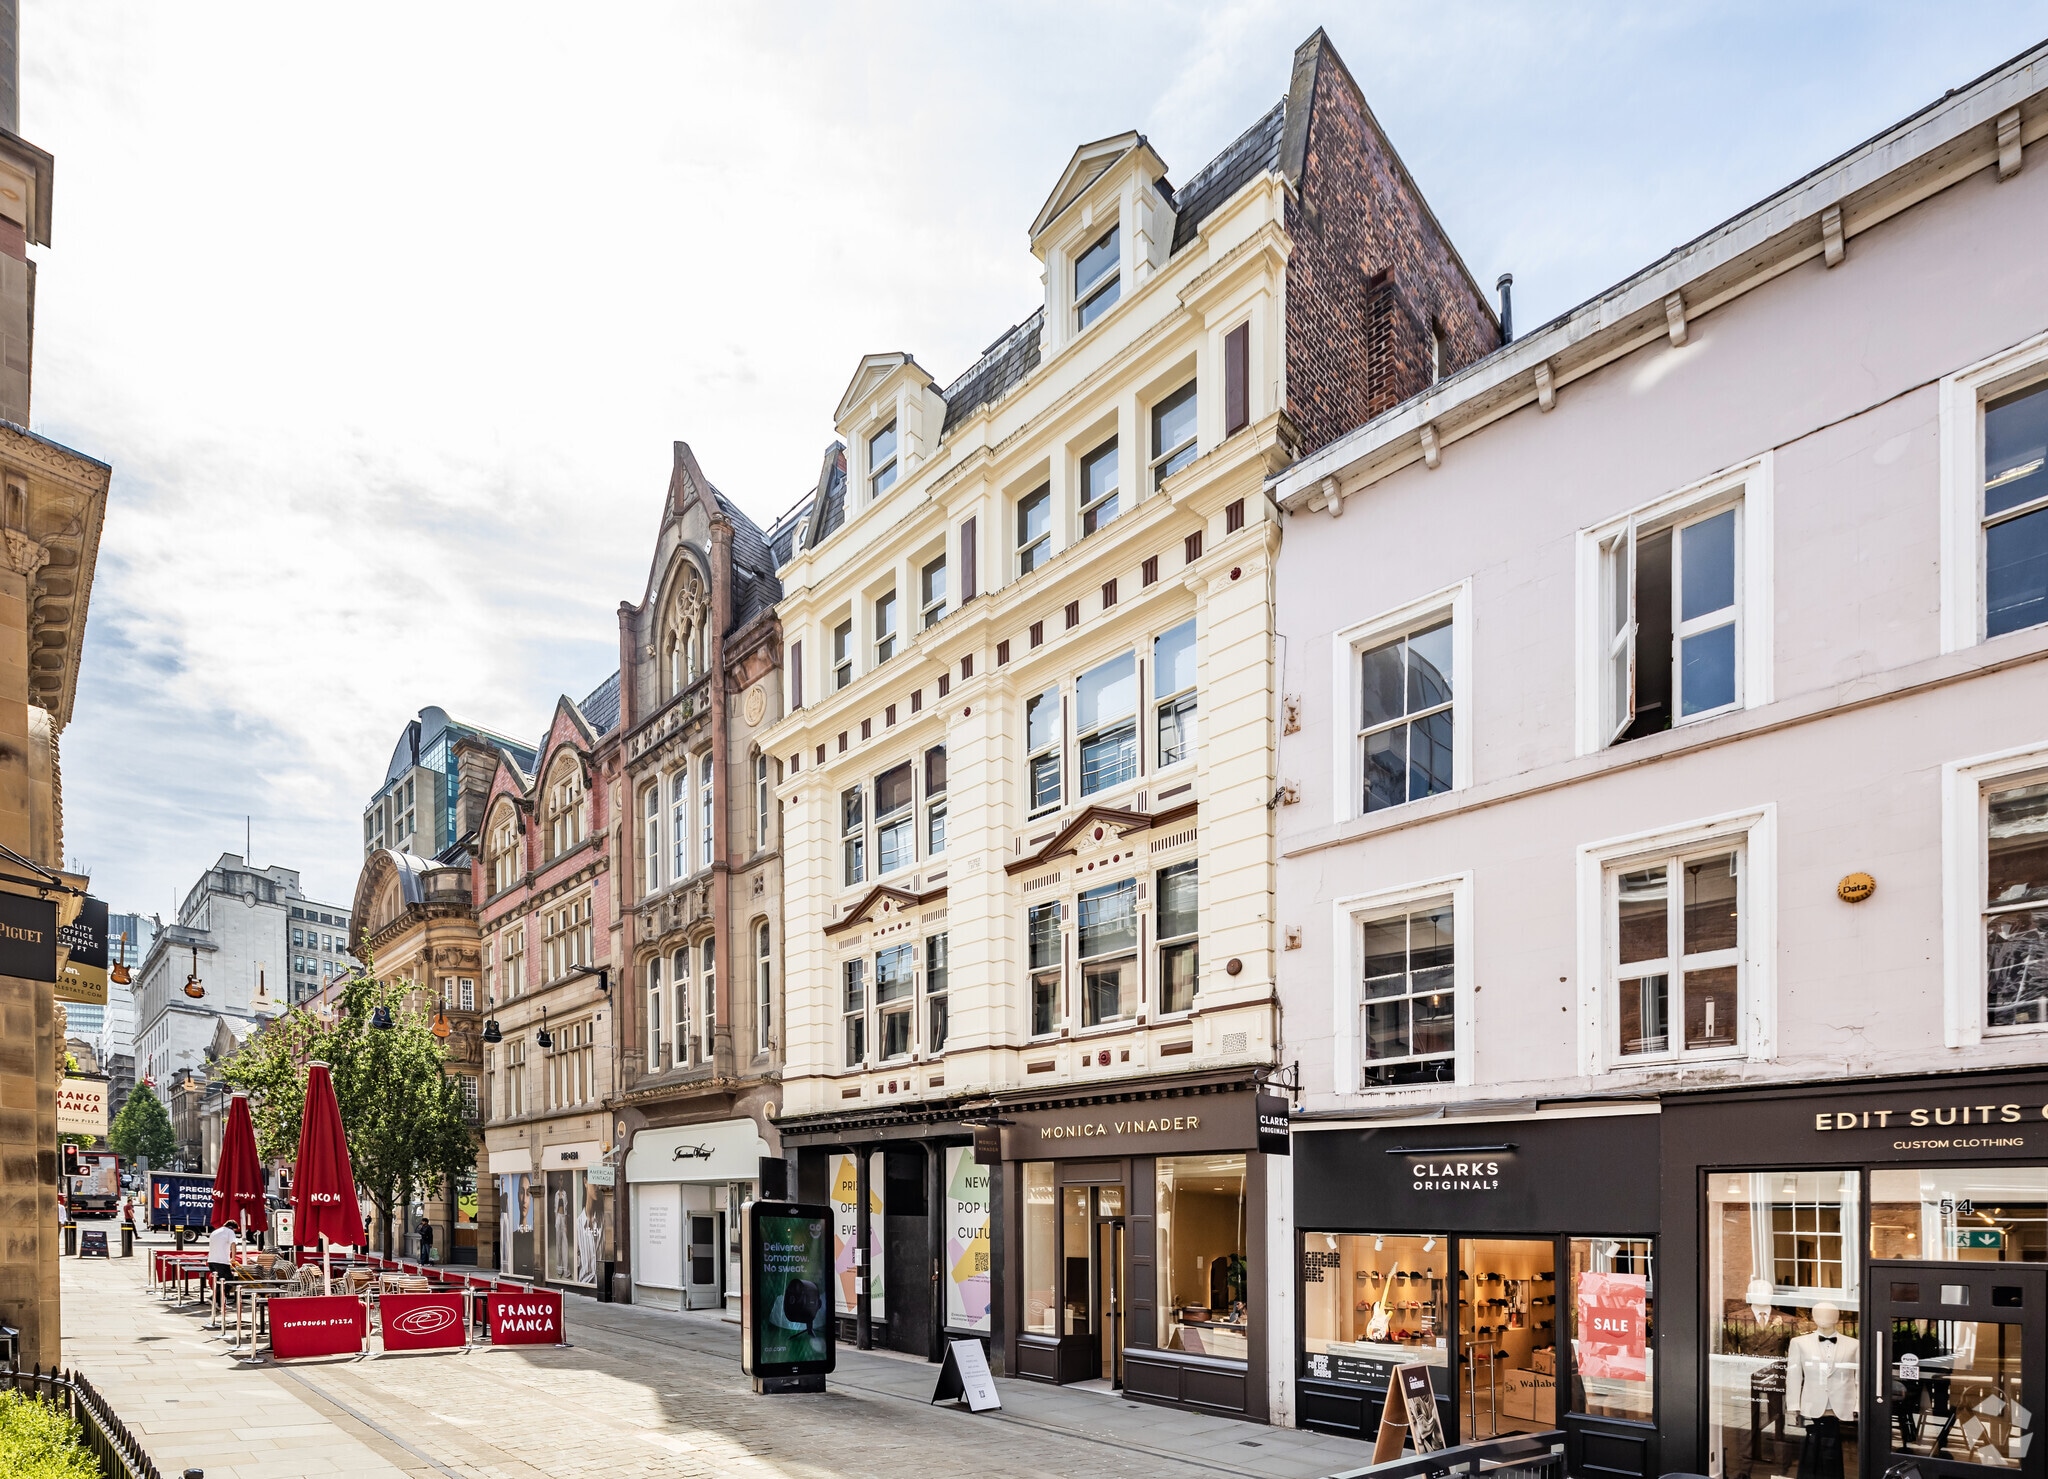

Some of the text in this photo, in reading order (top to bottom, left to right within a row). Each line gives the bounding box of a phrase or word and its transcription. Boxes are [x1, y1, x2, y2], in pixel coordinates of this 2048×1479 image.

[1843, 884, 1868, 894] Data
[62, 927, 93, 941] OFFICE
[71, 923, 93, 933] ALITY
[61, 933, 99, 949] TERRACE
[77, 945, 87, 953] FT
[82, 981, 102, 991] 920
[57, 1090, 101, 1102] RANCO
[1260, 1114, 1289, 1127] CLARKS
[1815, 1110, 1893, 1131] EDIT
[1910, 1103, 2021, 1127] SUITS
[1041, 1116, 1200, 1139] MONICA VINADER
[1893, 1137, 2024, 1150] CUSTOM CLOTHING
[1413, 1162, 1499, 1177] CLARKS
[965, 1176, 990, 1188] NEW
[1413, 1180, 1499, 1190] ORIGINALS
[179, 1200, 213, 1208] POTATO
[957, 1202, 981, 1213] POP
[1940, 1199, 1974, 1215] 54
[957, 1227, 991, 1239] CULTU
[763, 1242, 805, 1252] Delivered
[763, 1254, 810, 1262] tomorrow.
[763, 1264, 807, 1273] No sweat.
[497, 1304, 553, 1317] FRANCO
[283, 1318, 353, 1328] SOURDOUGH PIZZA
[500, 1318, 554, 1333] MANCA
[1593, 1317, 1629, 1332] SALE
[1520, 1380, 1556, 1388] Wallabe
